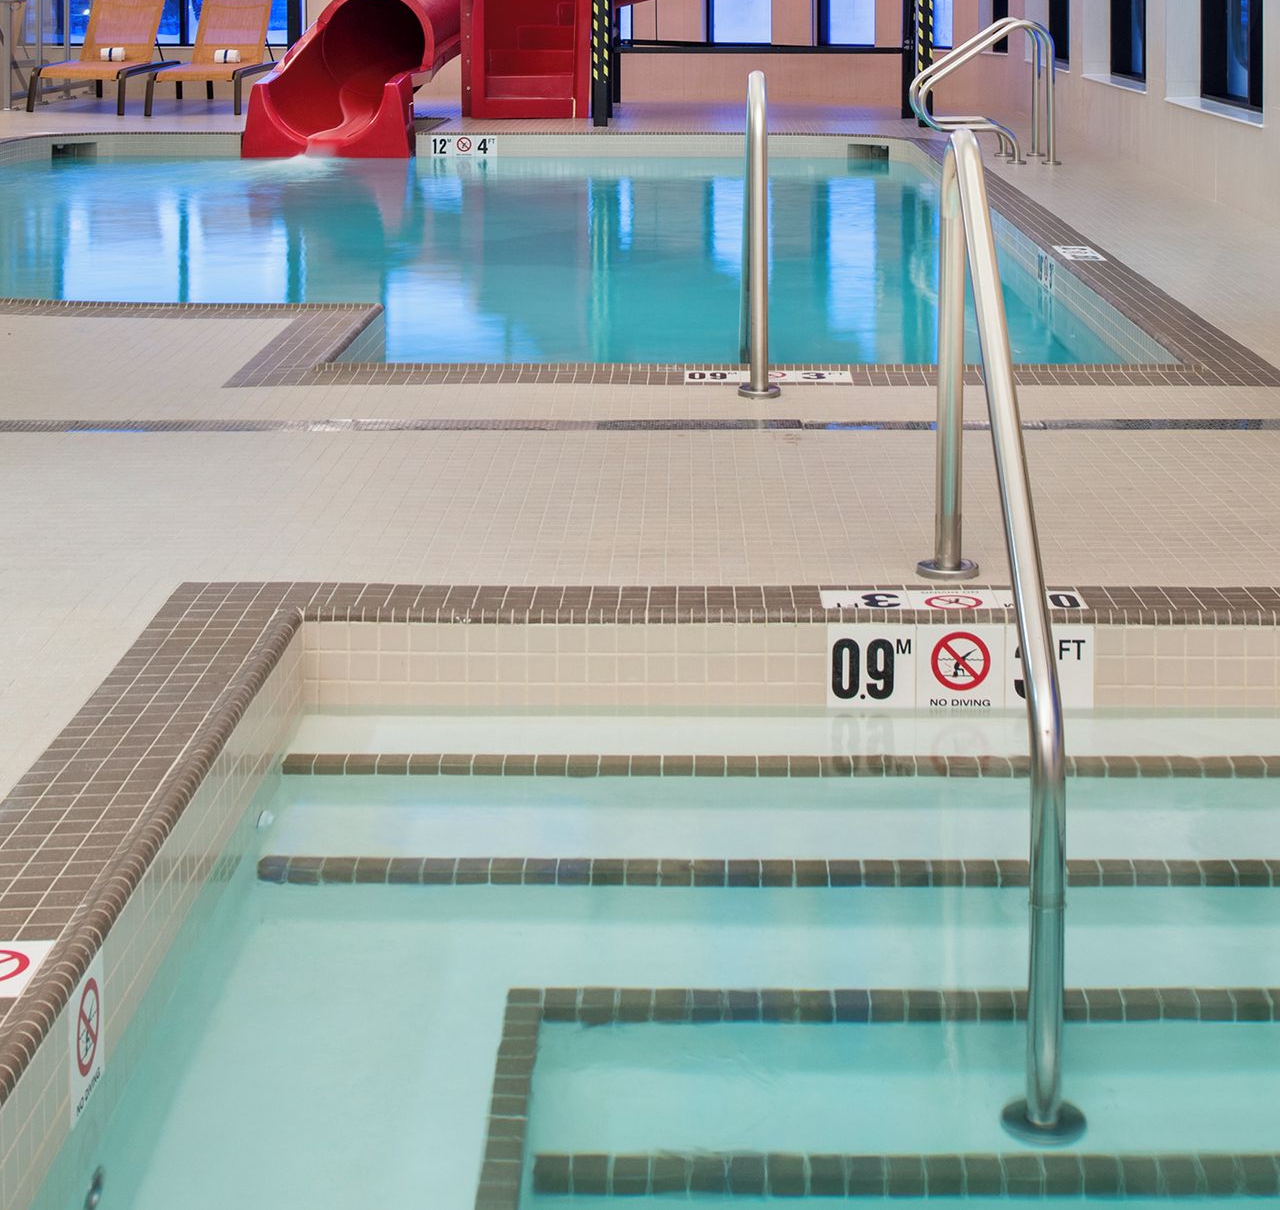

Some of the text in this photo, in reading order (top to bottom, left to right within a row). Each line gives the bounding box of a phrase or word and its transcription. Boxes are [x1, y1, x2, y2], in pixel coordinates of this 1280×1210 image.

[1058, 640, 1086, 660] FT
[929, 698, 991, 707] NO DIVING
